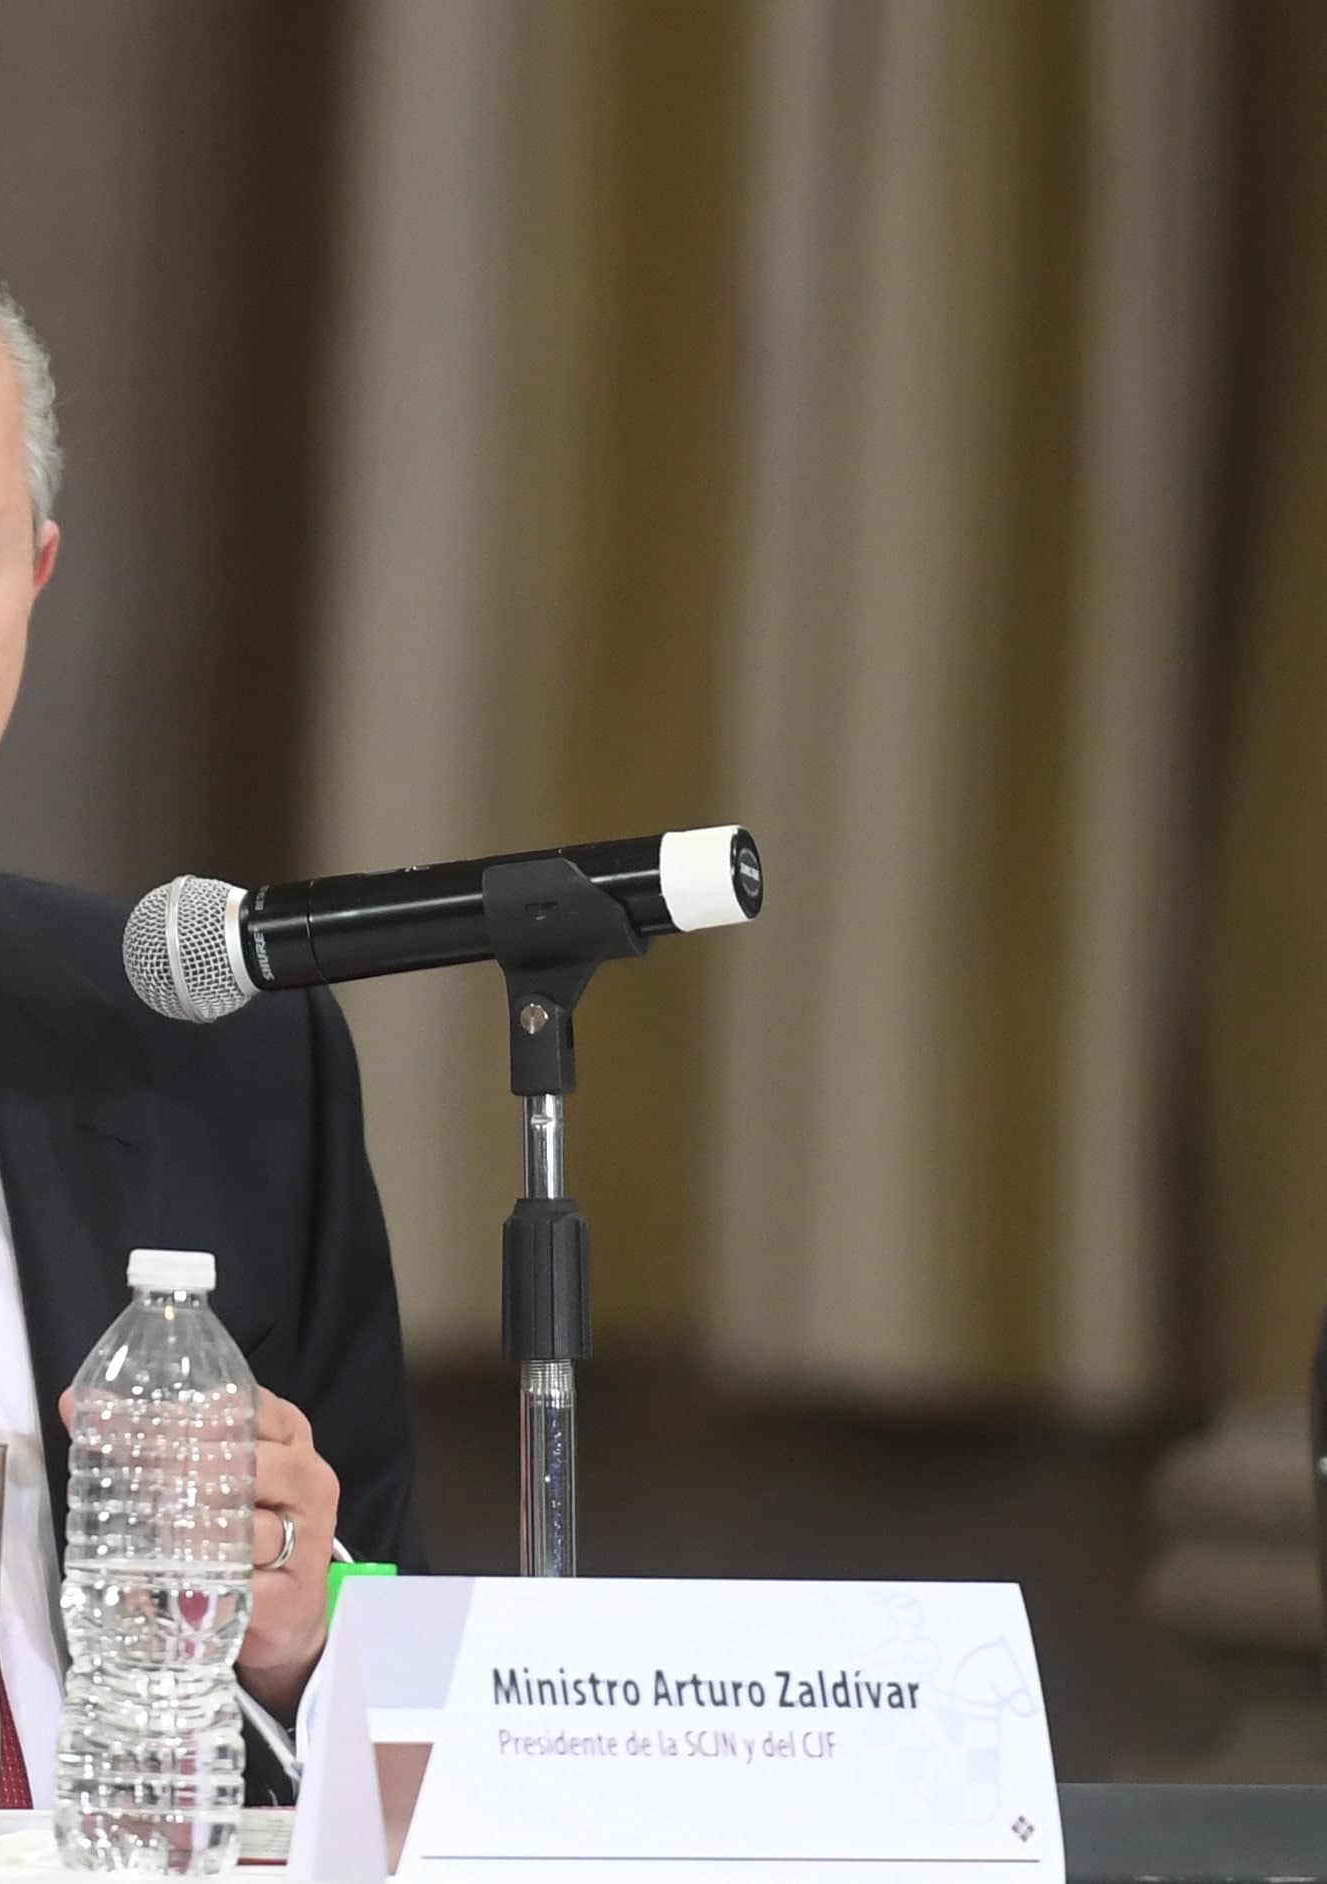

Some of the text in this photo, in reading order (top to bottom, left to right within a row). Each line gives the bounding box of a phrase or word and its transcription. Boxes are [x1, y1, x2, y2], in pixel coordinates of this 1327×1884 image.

[253, 931, 275, 981] SHURE
[492, 1667, 920, 1709] Ministro Arturo Zaldívar
[498, 1728, 836, 1765] Presidente de la SCJN y del CJF
